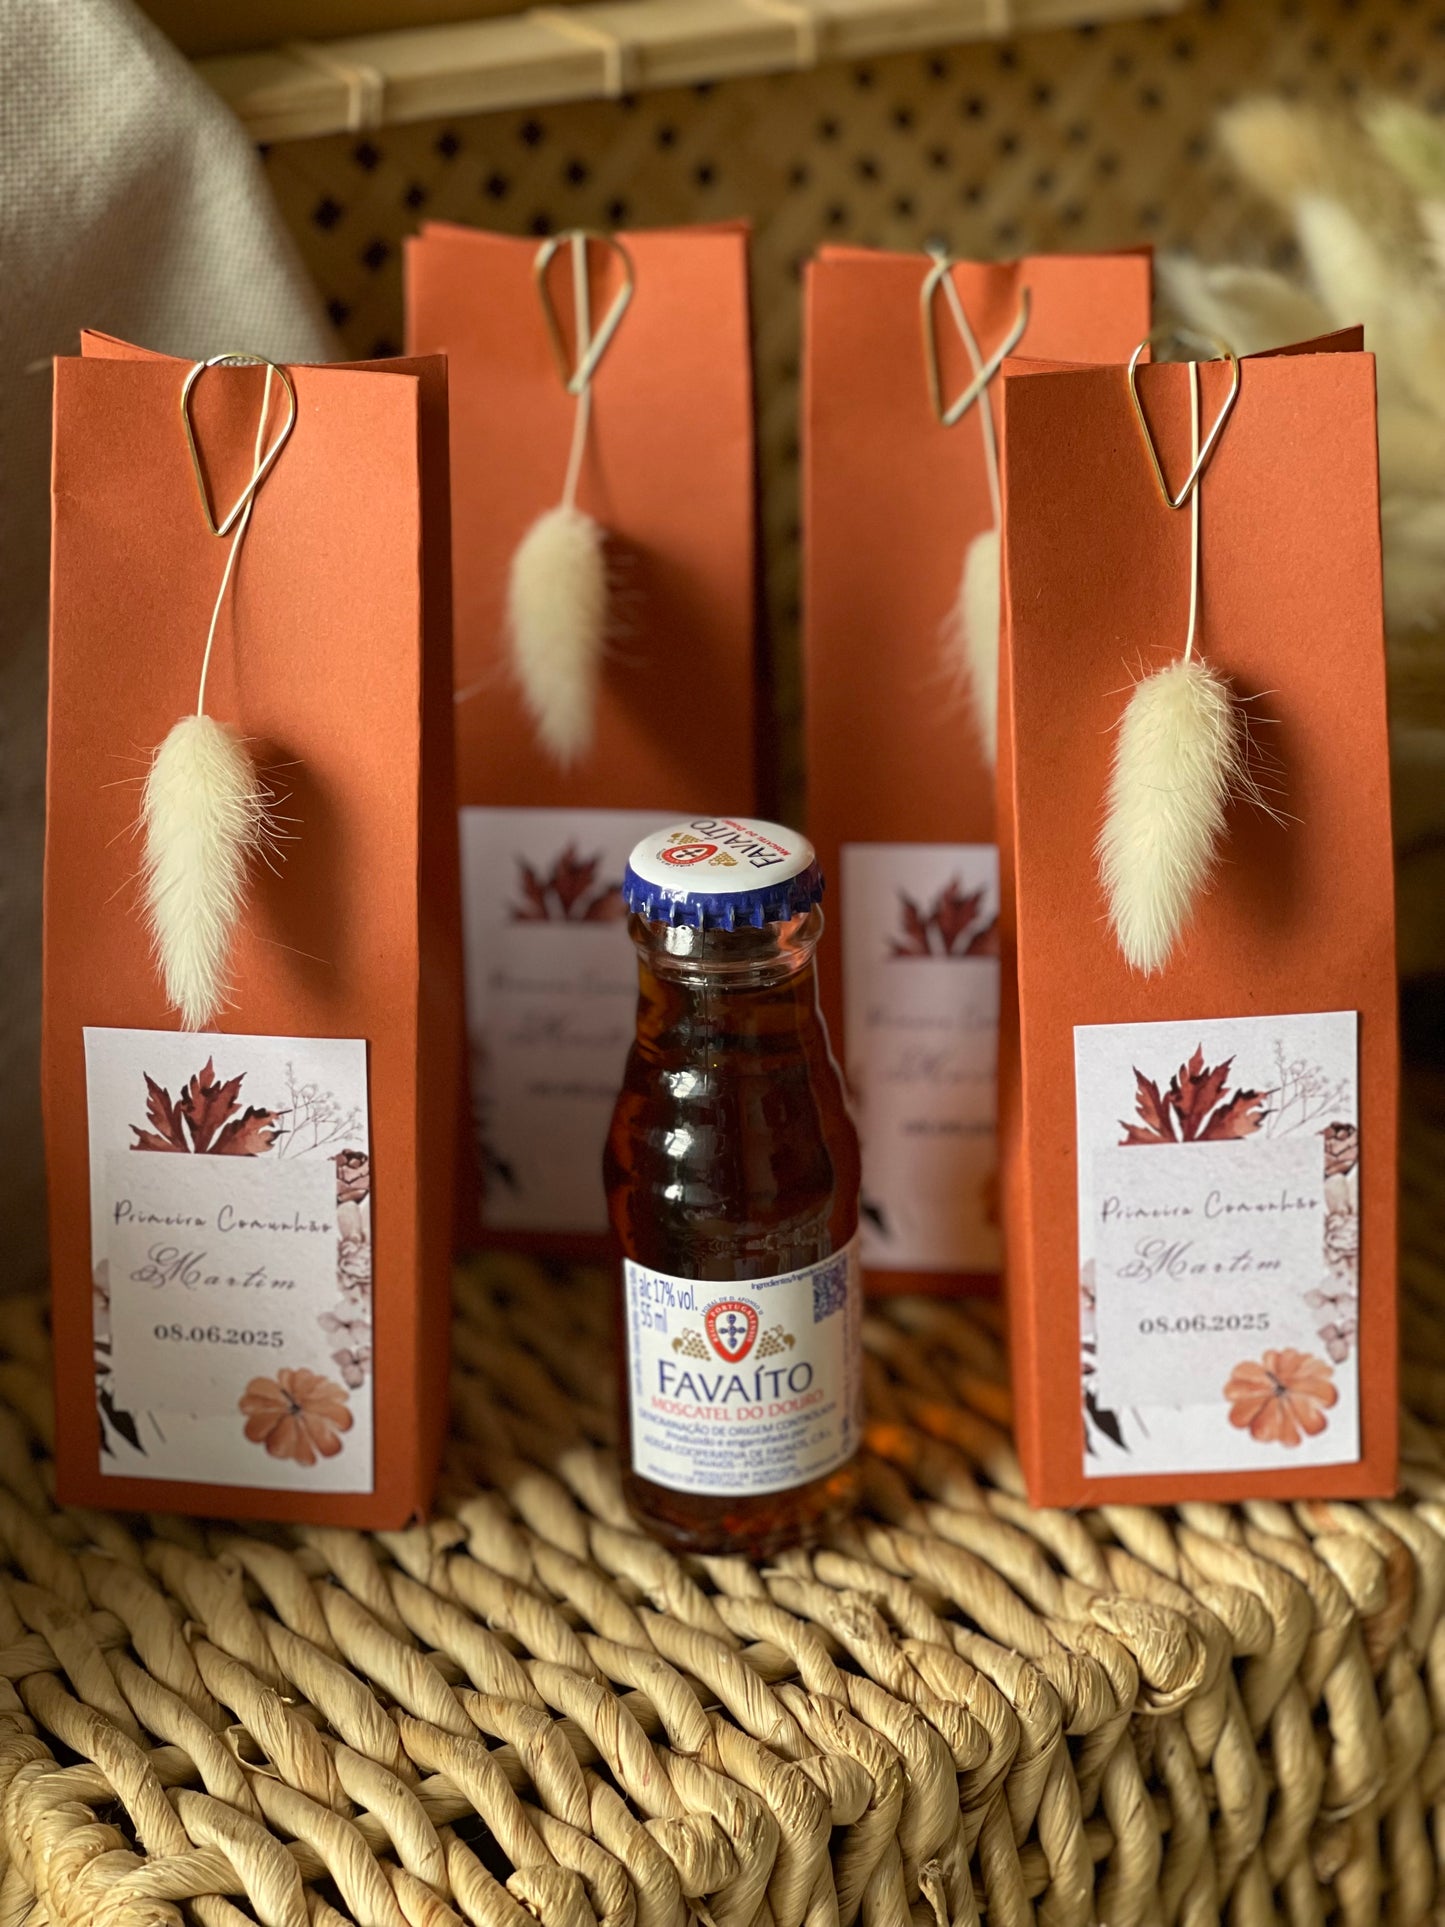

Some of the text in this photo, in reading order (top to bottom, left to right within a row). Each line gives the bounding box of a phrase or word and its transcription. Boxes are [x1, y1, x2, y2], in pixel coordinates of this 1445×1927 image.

[690, 818, 785, 868] FAVAÍTO
[113, 1199, 207, 1226] Primeira
[1101, 1195, 1194, 1224] Primeira
[129, 1242, 296, 1291] Martim
[1116, 1235, 1283, 1284] Martim
[654, 1277, 676, 1308] 17%
[677, 1284, 699, 1312] vol.
[640, 1301, 668, 1334] 55 ml
[1138, 1312, 1271, 1335] 08.06.2025
[153, 1323, 285, 1349] 08.06.2025
[657, 1358, 814, 1404] FAVAÍTO
[651, 1388, 824, 1421] MOSCATEL DO DOURO
